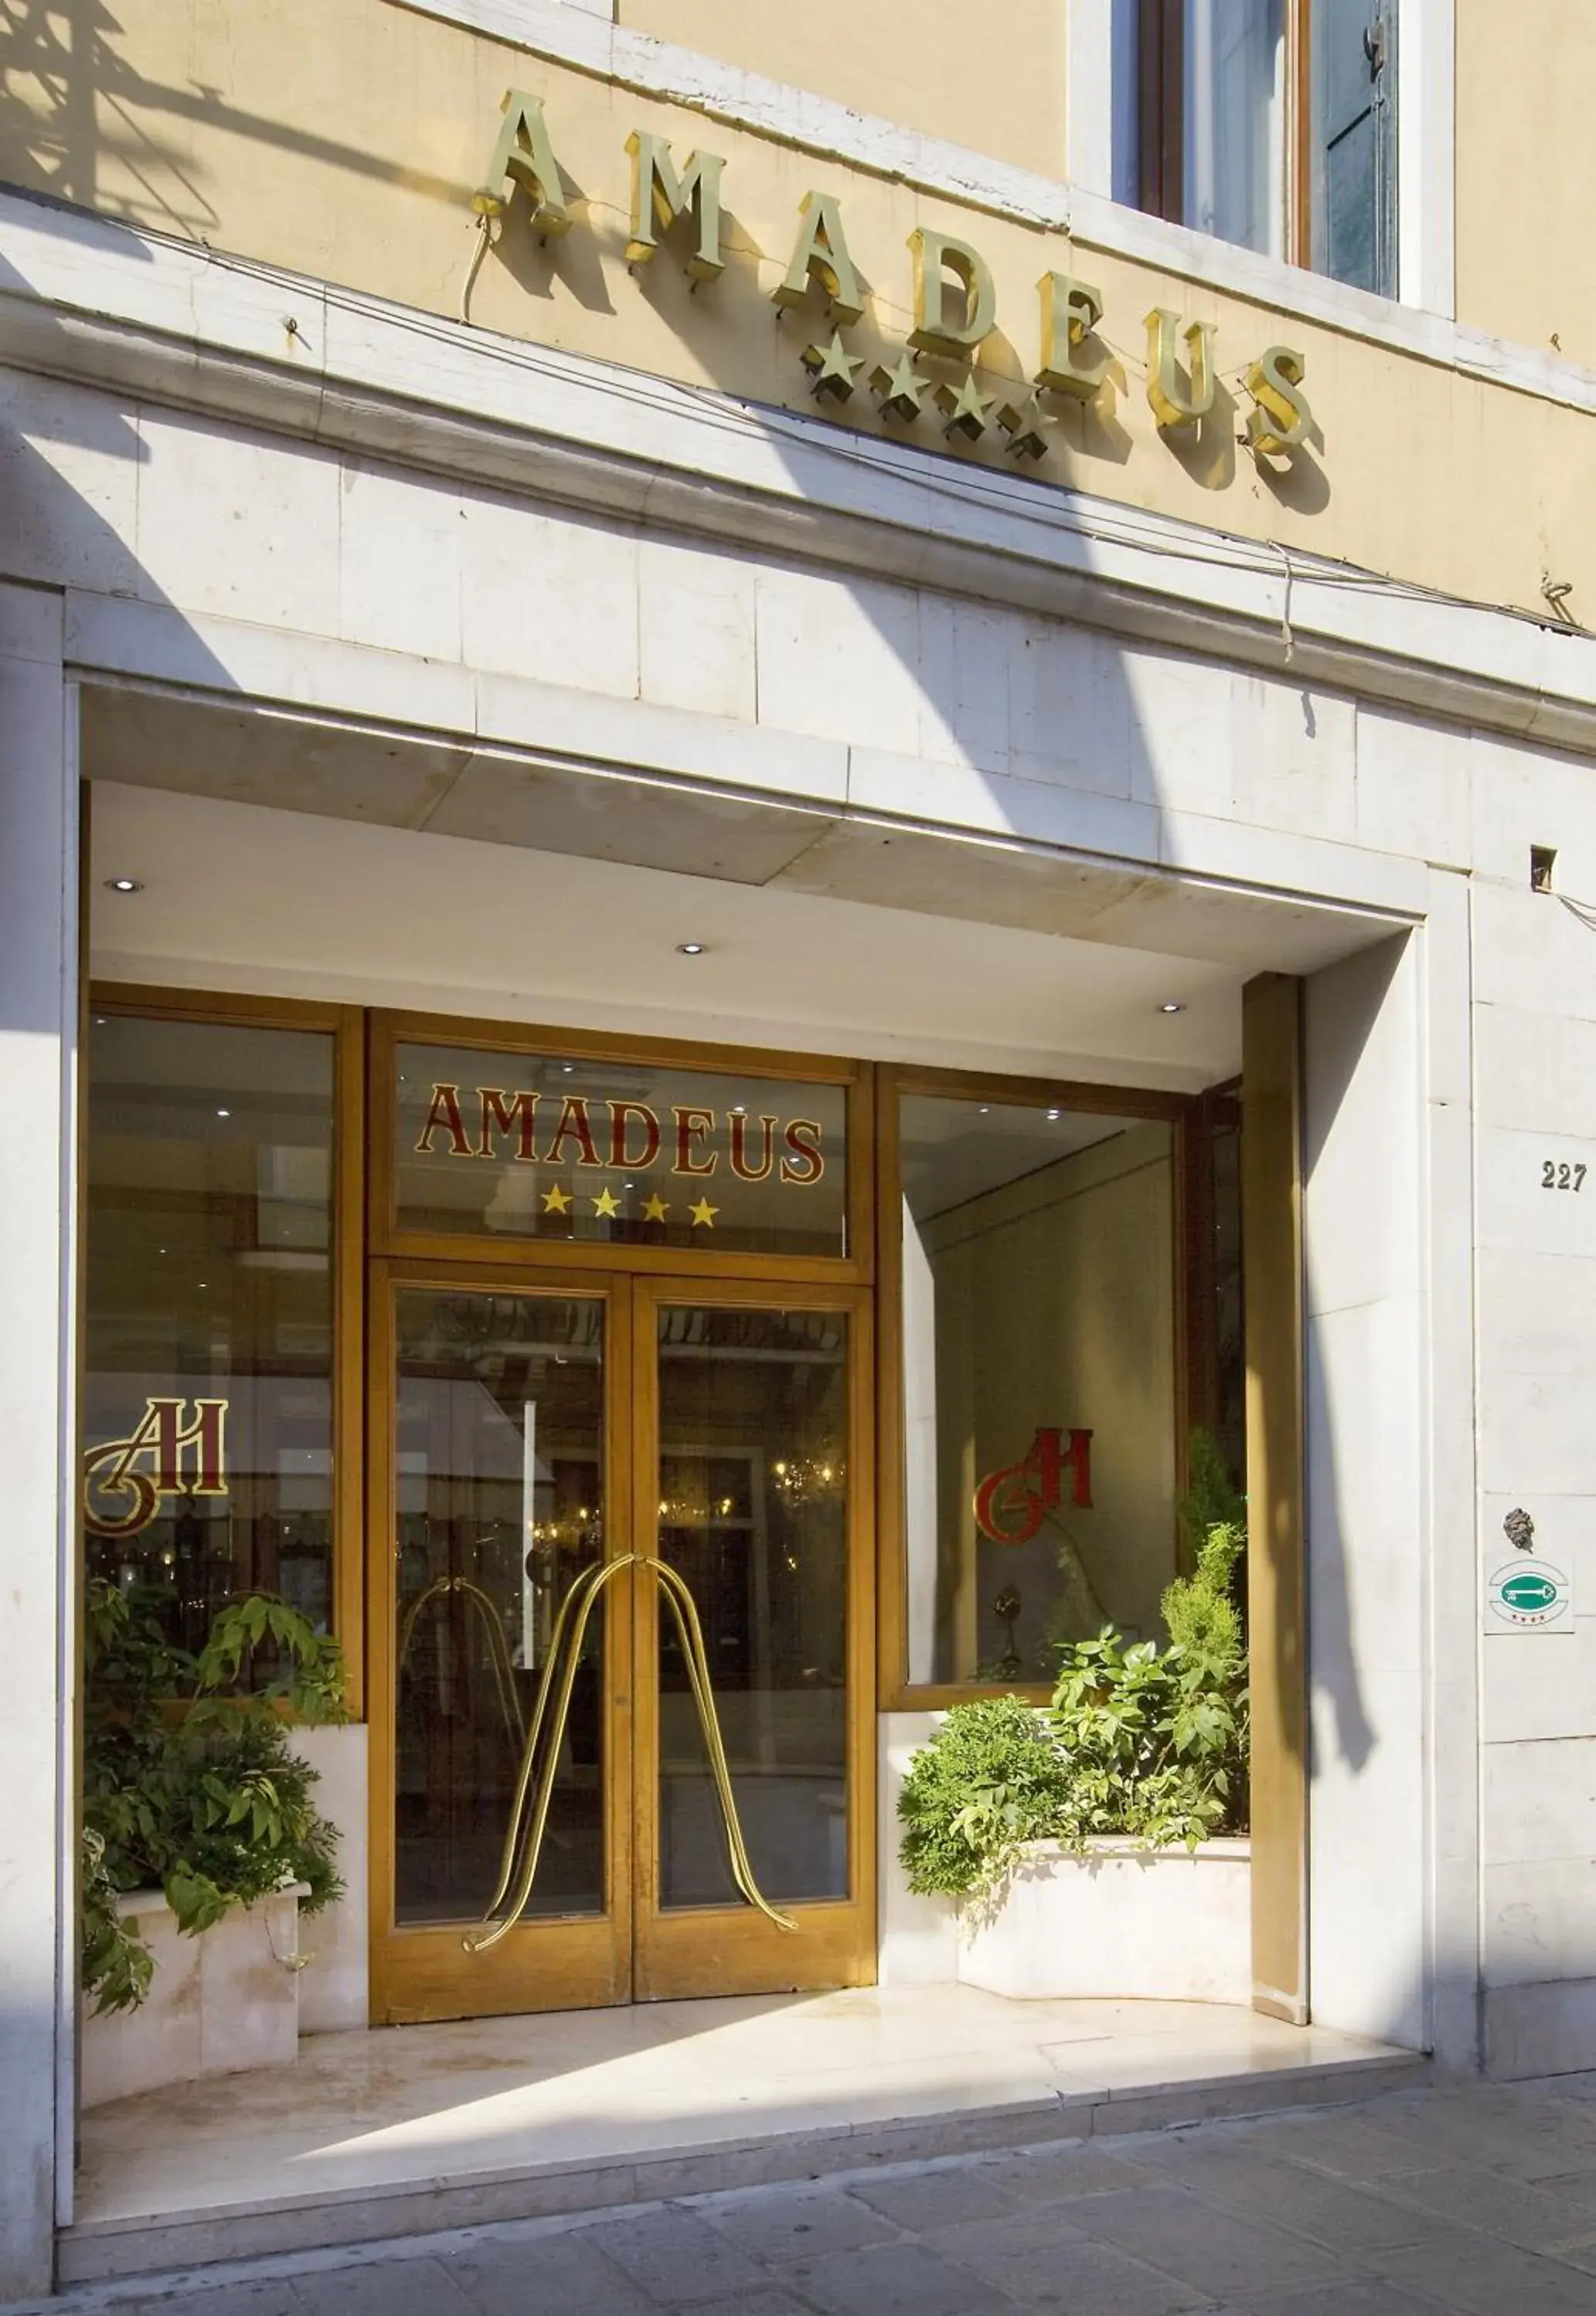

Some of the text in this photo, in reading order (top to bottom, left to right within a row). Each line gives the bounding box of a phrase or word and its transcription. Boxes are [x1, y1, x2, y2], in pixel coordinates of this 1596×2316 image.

[472, 87, 1314, 455] AMADEUS
[415, 1083, 823, 1184] AMADEUS
[1541, 1160, 1588, 1193] 227
